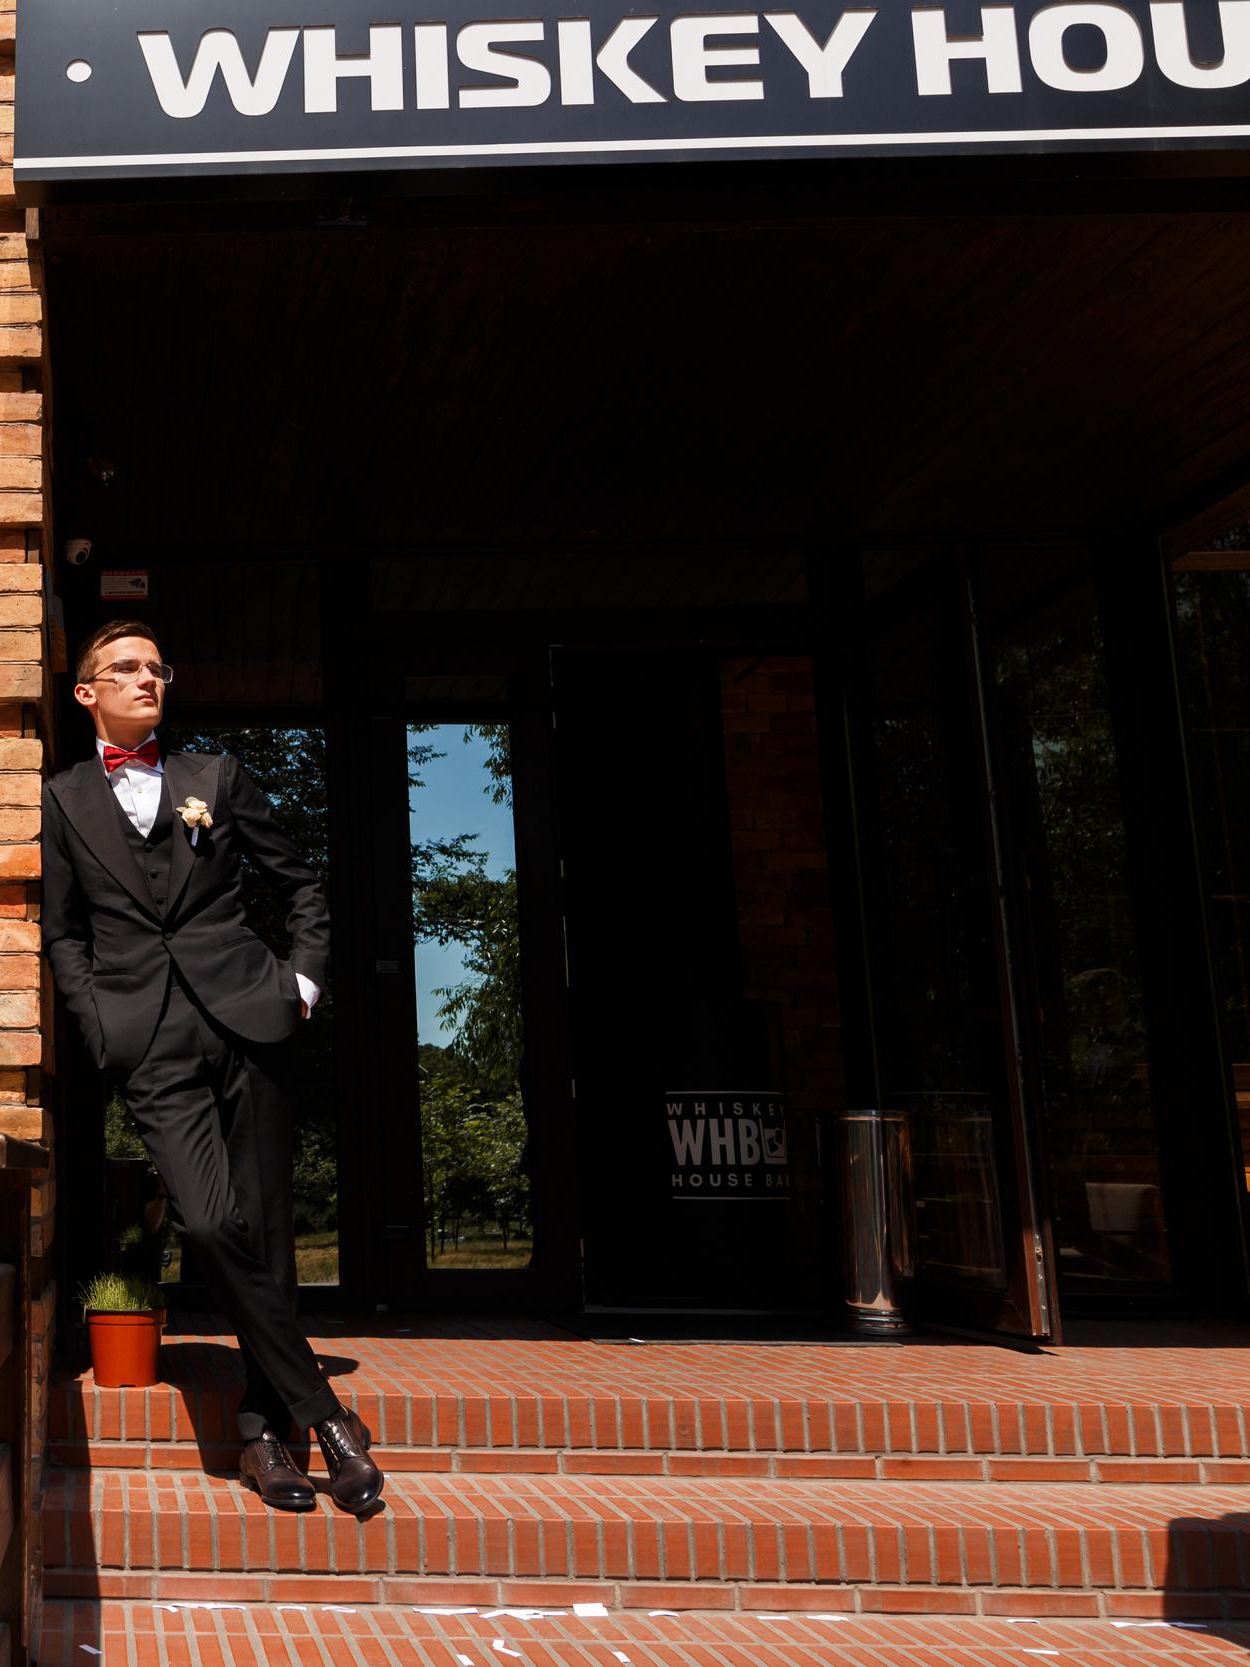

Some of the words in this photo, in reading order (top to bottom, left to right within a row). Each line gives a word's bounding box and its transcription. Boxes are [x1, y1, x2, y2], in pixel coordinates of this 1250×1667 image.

[135, 11, 884, 119] WHISKEY
[910, 1, 1250, 97] HOU
[666, 1101, 784, 1117] WHISKEY
[667, 1118, 761, 1166] WHB
[671, 1173, 753, 1187] HOUSE
[765, 1173, 790, 1187] BAR
